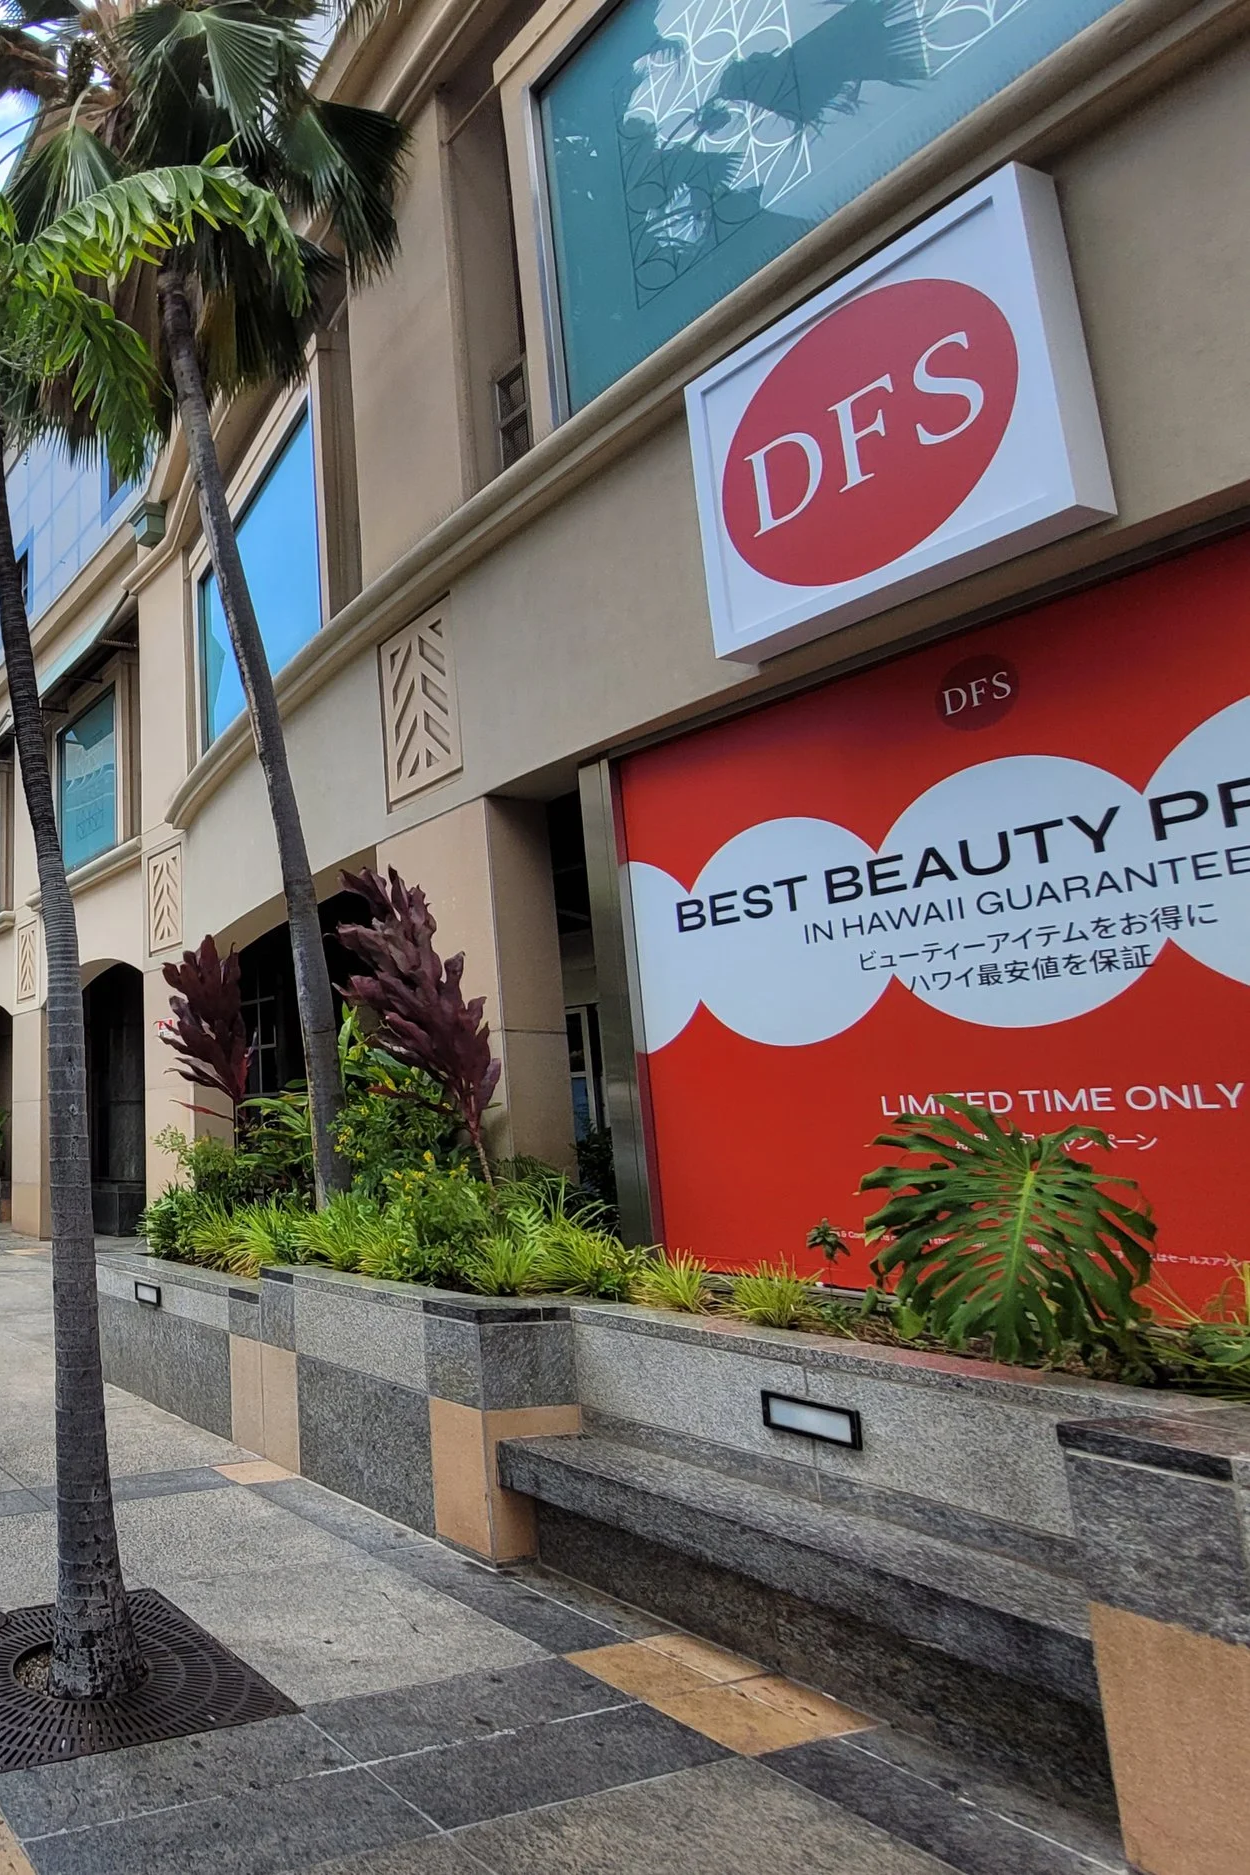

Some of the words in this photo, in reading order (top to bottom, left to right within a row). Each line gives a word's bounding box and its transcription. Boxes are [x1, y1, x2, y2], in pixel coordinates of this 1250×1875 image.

[743, 331, 984, 538] DFS
[942, 671, 1012, 716] DFS
[676, 875, 807, 933] BEST
[824, 805, 1120, 905] BEAUTY
[803, 920, 833, 944] IN
[842, 897, 965, 938] HAWAII
[976, 845, 1250, 915] GUARANTEE
[859, 903, 1219, 972] ビューティーアイテムをお得に
[909, 944, 1155, 992] ハワイ最安値を保証
[1018, 1087, 1116, 1113] TIME
[1125, 1082, 1244, 1111] ONLY
